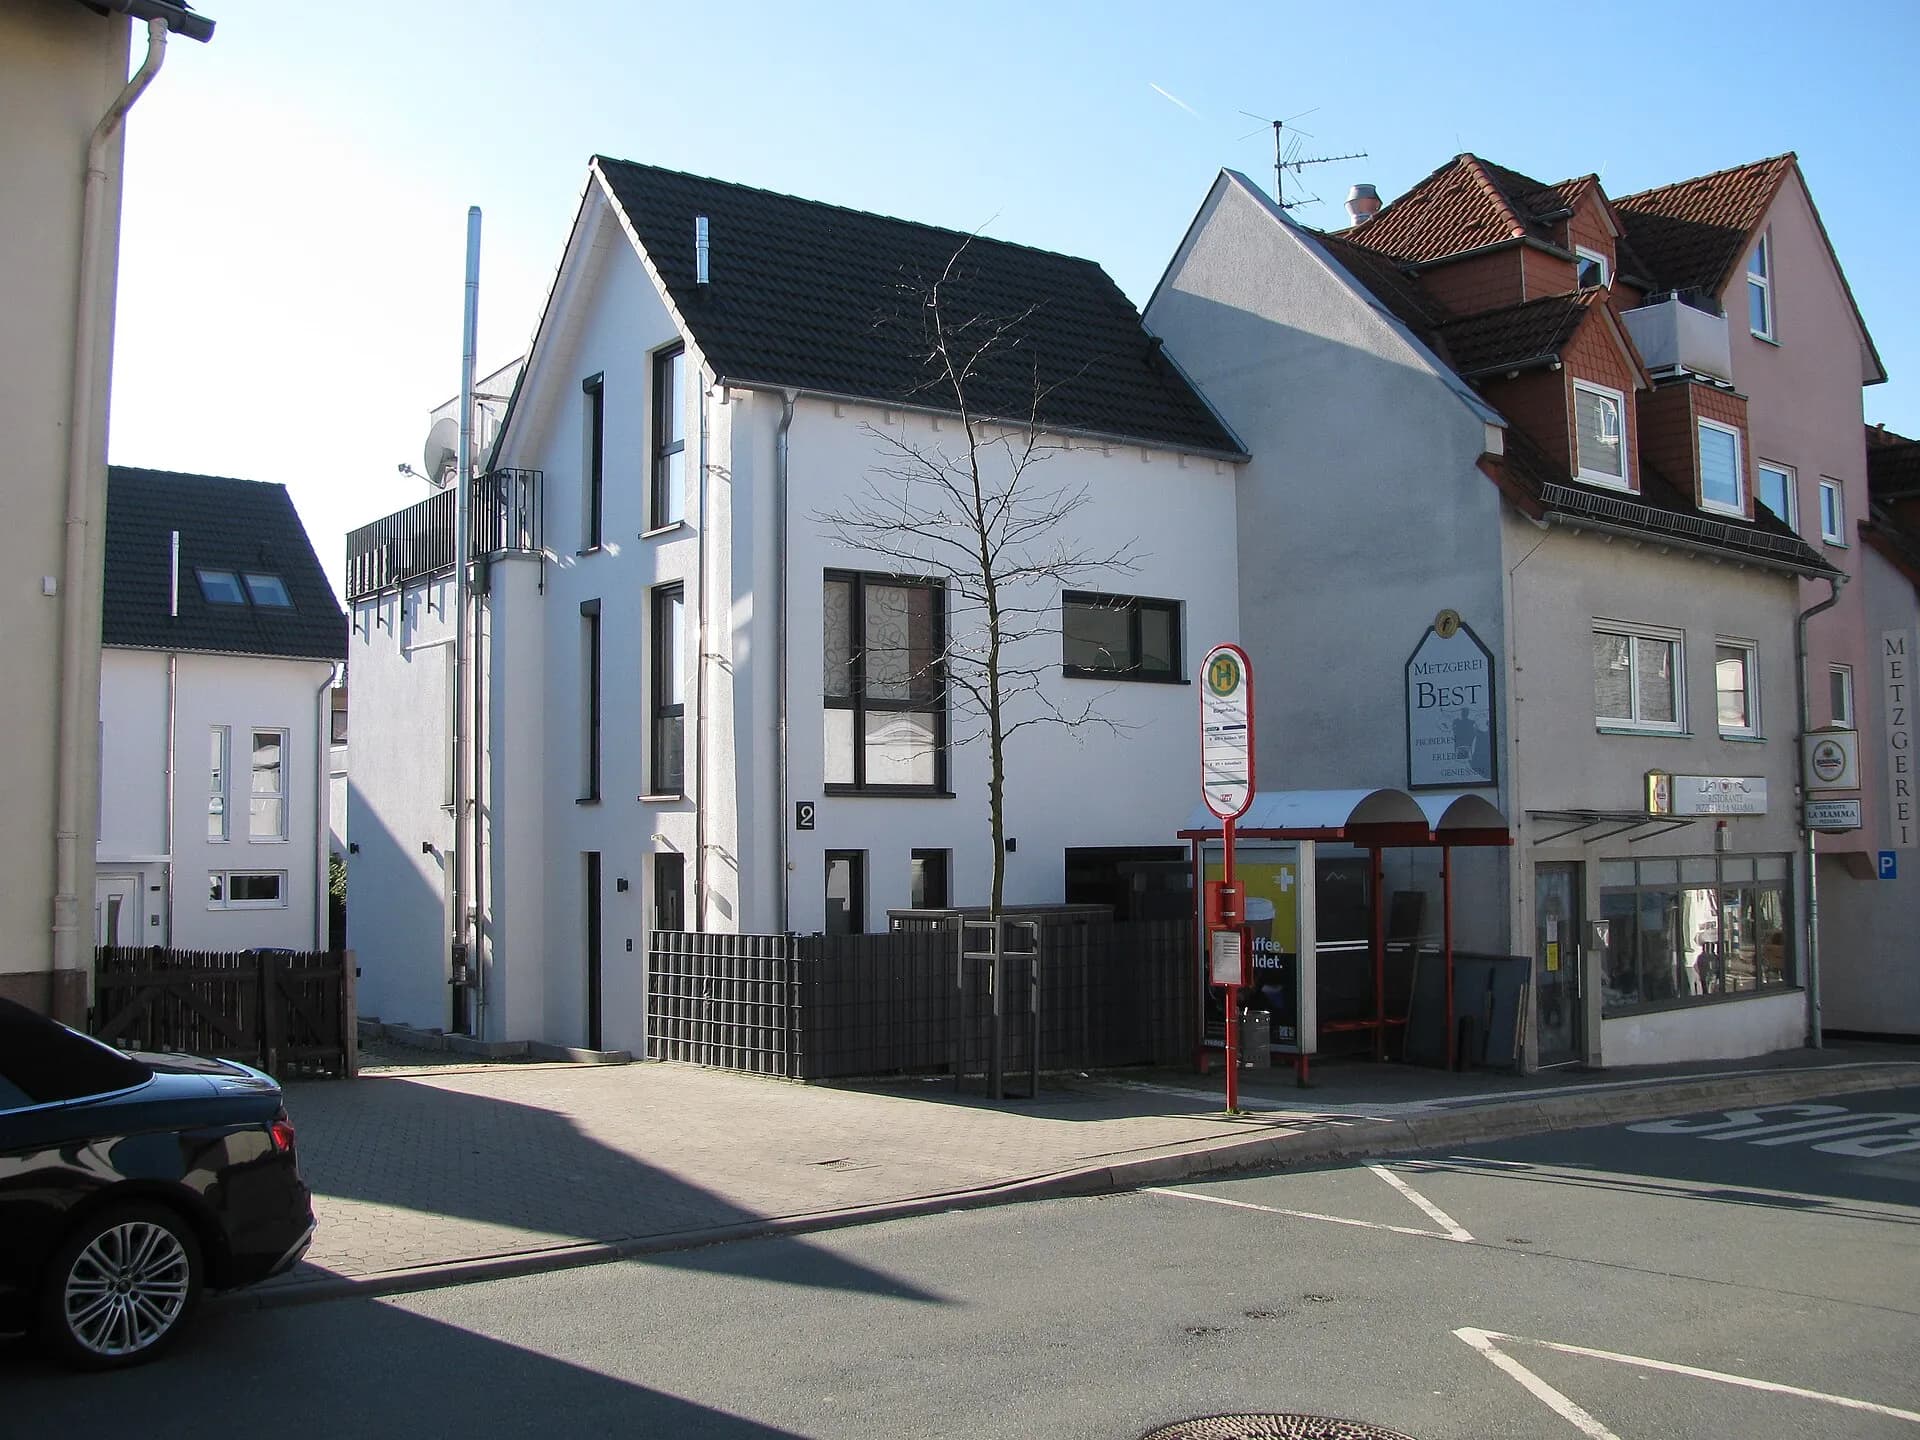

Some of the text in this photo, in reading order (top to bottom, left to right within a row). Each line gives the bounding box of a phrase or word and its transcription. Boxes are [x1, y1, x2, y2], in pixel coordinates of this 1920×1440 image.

[1216, 663, 1232, 687] H
[1884, 637, 1911, 844] METZGEREI
[801, 806, 813, 826] 2
[1808, 810, 1856, 819] LA MAMMA
[1881, 856, 1893, 873] P
